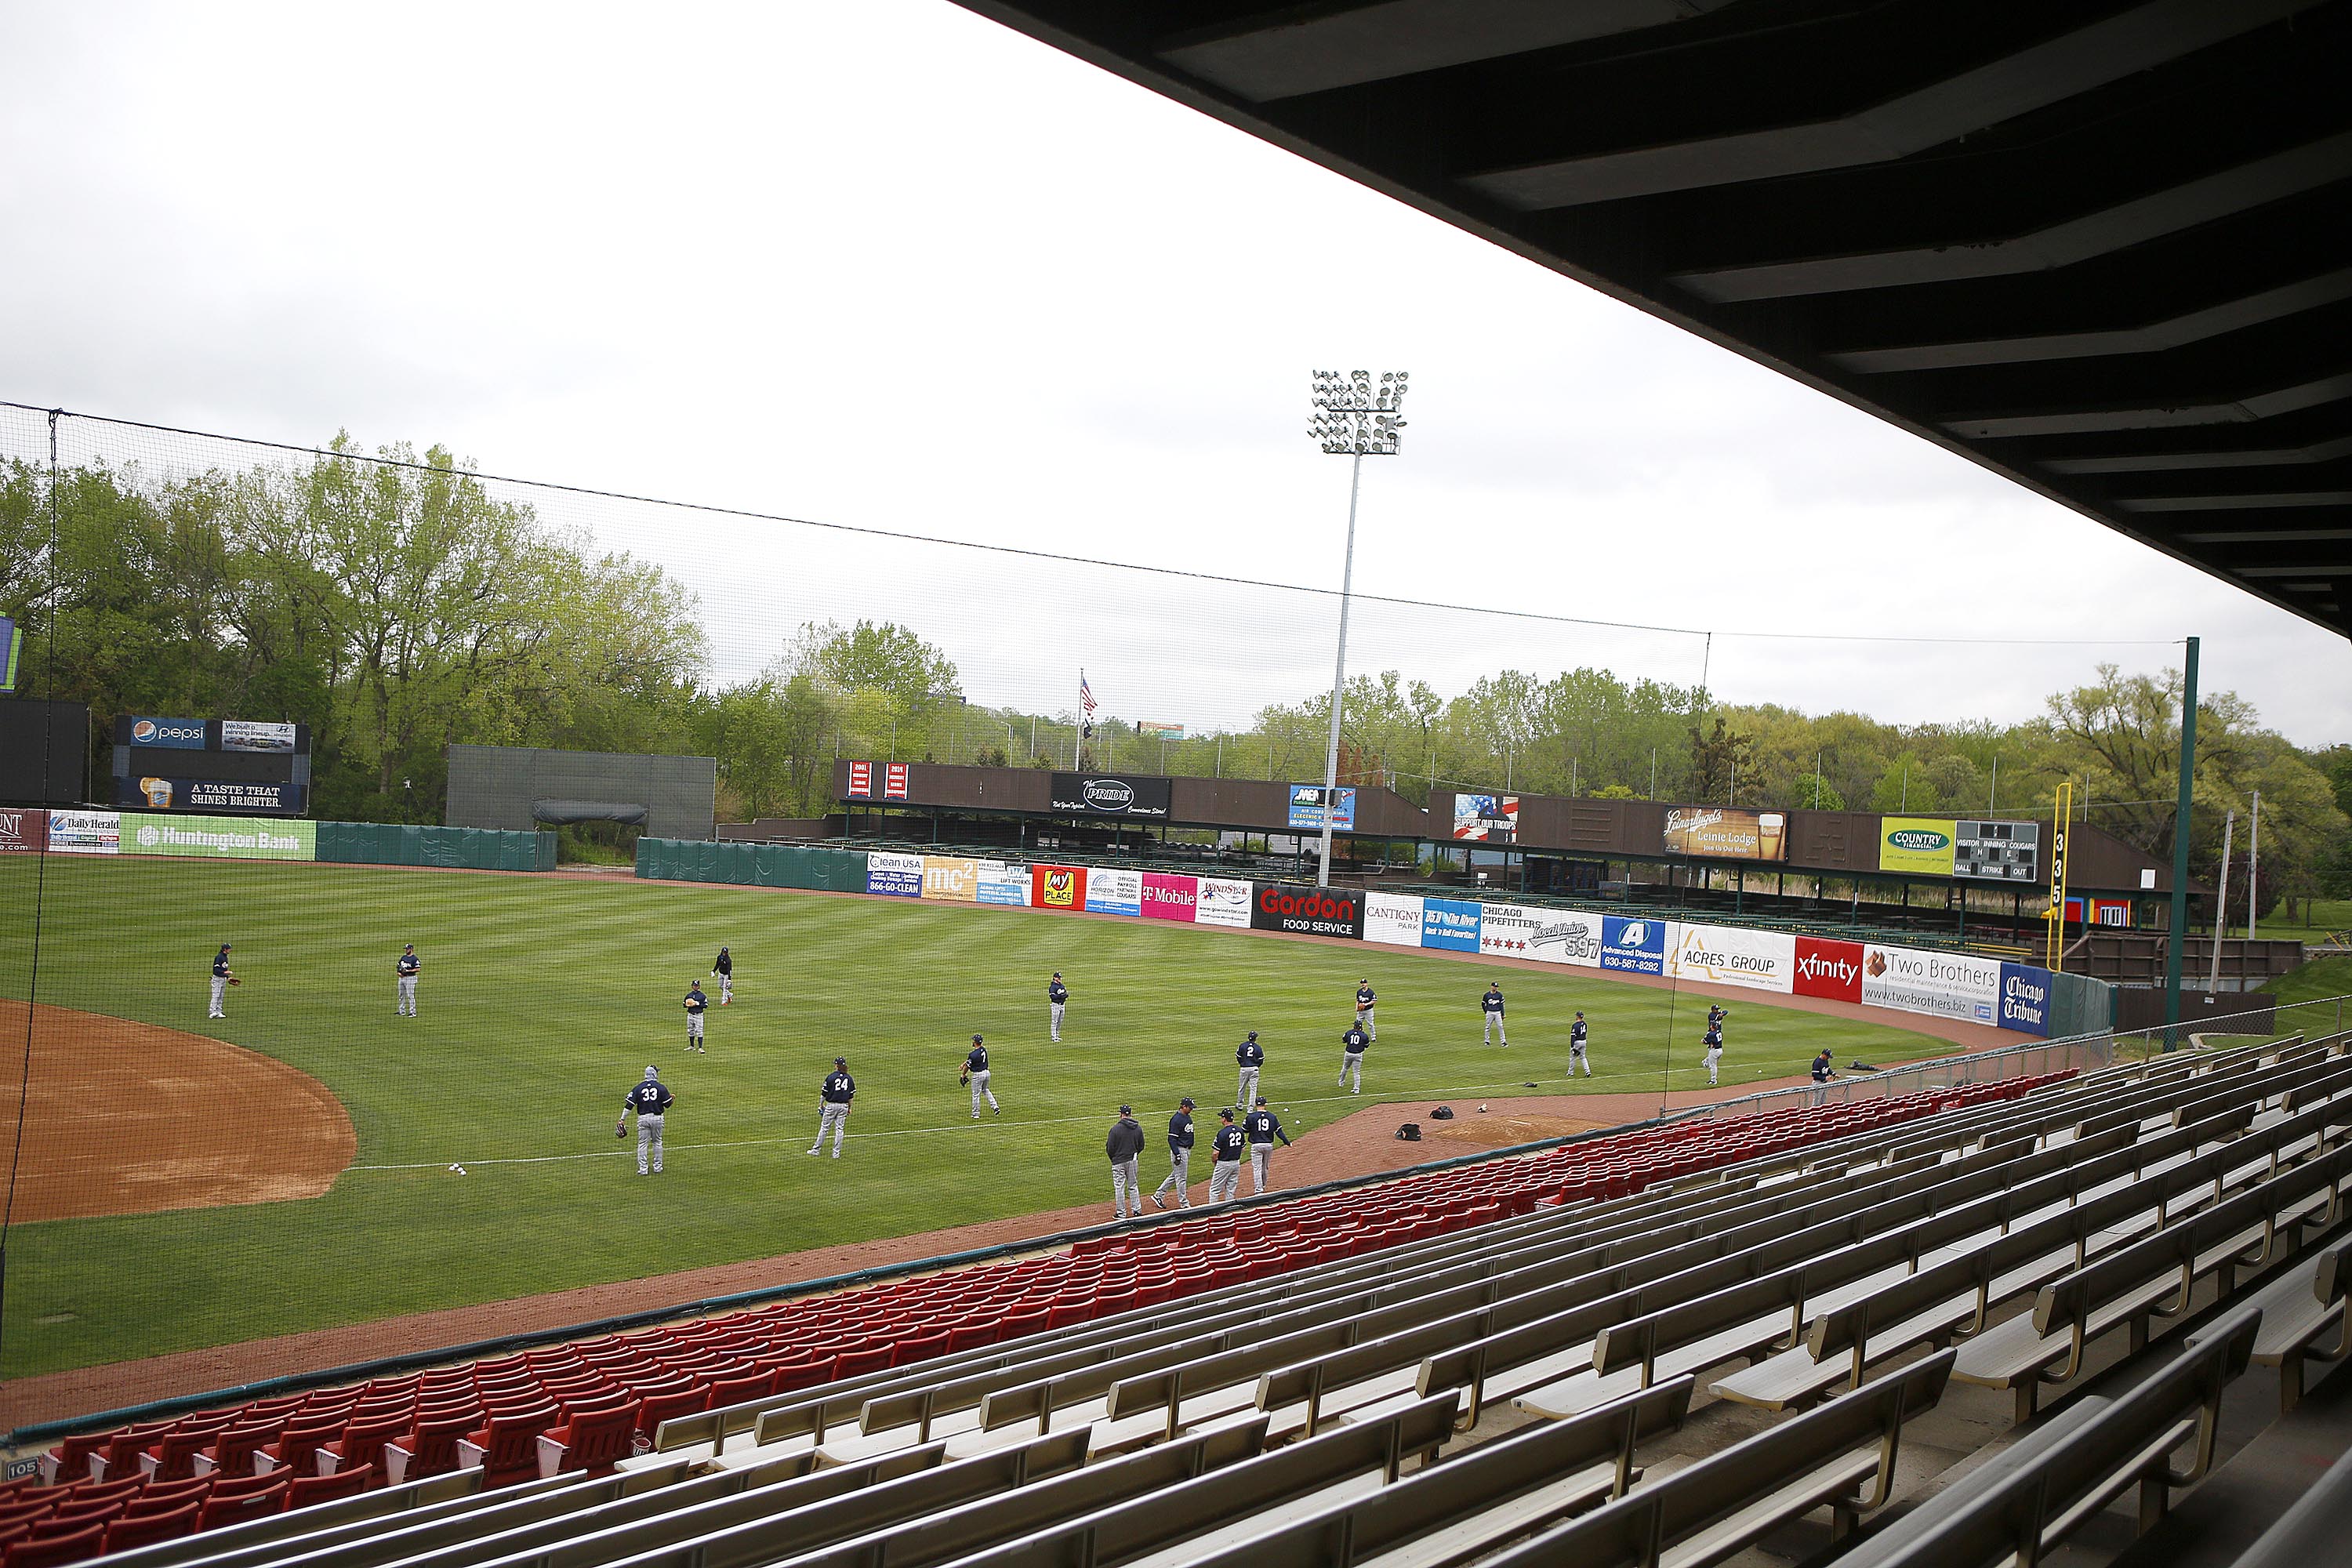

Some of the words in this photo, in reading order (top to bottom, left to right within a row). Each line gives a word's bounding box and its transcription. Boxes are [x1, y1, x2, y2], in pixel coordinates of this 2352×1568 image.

[158, 728, 204, 741] pepsi
[191, 784, 201, 793] A
[204, 785, 244, 795] TASTE
[246, 786, 280, 797] THAT
[1087, 788, 1131, 801] PRIDE
[191, 794, 227, 805] SHINES
[230, 796, 282, 808] BRIGHTER.
[68, 818, 90, 829] Daily
[92, 819, 119, 829] Herald
[1456, 818, 1481, 827] SUPPORT
[1481, 820, 1494, 829] OUR
[1494, 820, 1516, 830] TROOPS
[162, 826, 256, 851] Huntington
[258, 832, 299, 850] Bank
[1697, 830, 1726, 842] Leinie
[1728, 833, 1756, 846] Lodge
[1895, 833, 1942, 845] COUNTRY
[902, 860, 921, 869] USA
[869, 881, 919, 894] 866-GO-CLEAN
[1045, 890, 1072, 900] PLACE
[1260, 888, 1354, 921] Gordon
[1483, 906, 1522, 917] CHICAGO
[1367, 906, 1421, 922] CANTIGNY
[1447, 913, 1460, 924] The
[1459, 913, 1479, 927] River
[1283, 919, 1310, 931] FOOD
[1312, 921, 1353, 935] SERVICE
[1425, 926, 1437, 935] Rock
[1450, 930, 1477, 940] Favorites!
[1532, 924, 1559, 938] Local
[1559, 920, 1587, 936] Union
[1621, 922, 1645, 946] A
[1565, 936, 1601, 959] 597
[1602, 944, 1635, 956] Advanced
[1635, 948, 1663, 960] Disposal
[1604, 956, 1659, 972] 630-587-8282
[1684, 950, 1725, 967] ACRES
[1731, 956, 1775, 972] GROUP
[1798, 952, 1859, 987] xfinity
[1889, 953, 1923, 976] Two
[1929, 958, 1995, 988] Brothers
[2005, 975, 2045, 1004] Chicago
[1865, 988, 1966, 1013] www.twobrothers.biz
[2004, 996, 2043, 1025] Tribune
[1350, 1034, 1360, 1045] 10
[1247, 1047, 1254, 1057] 2
[834, 1078, 848, 1091] 24
[641, 1087, 658, 1101] 33
[1257, 1118, 1270, 1131] 19
[1229, 1131, 1242, 1146] 22
[10, 1461, 36, 1477] 105
